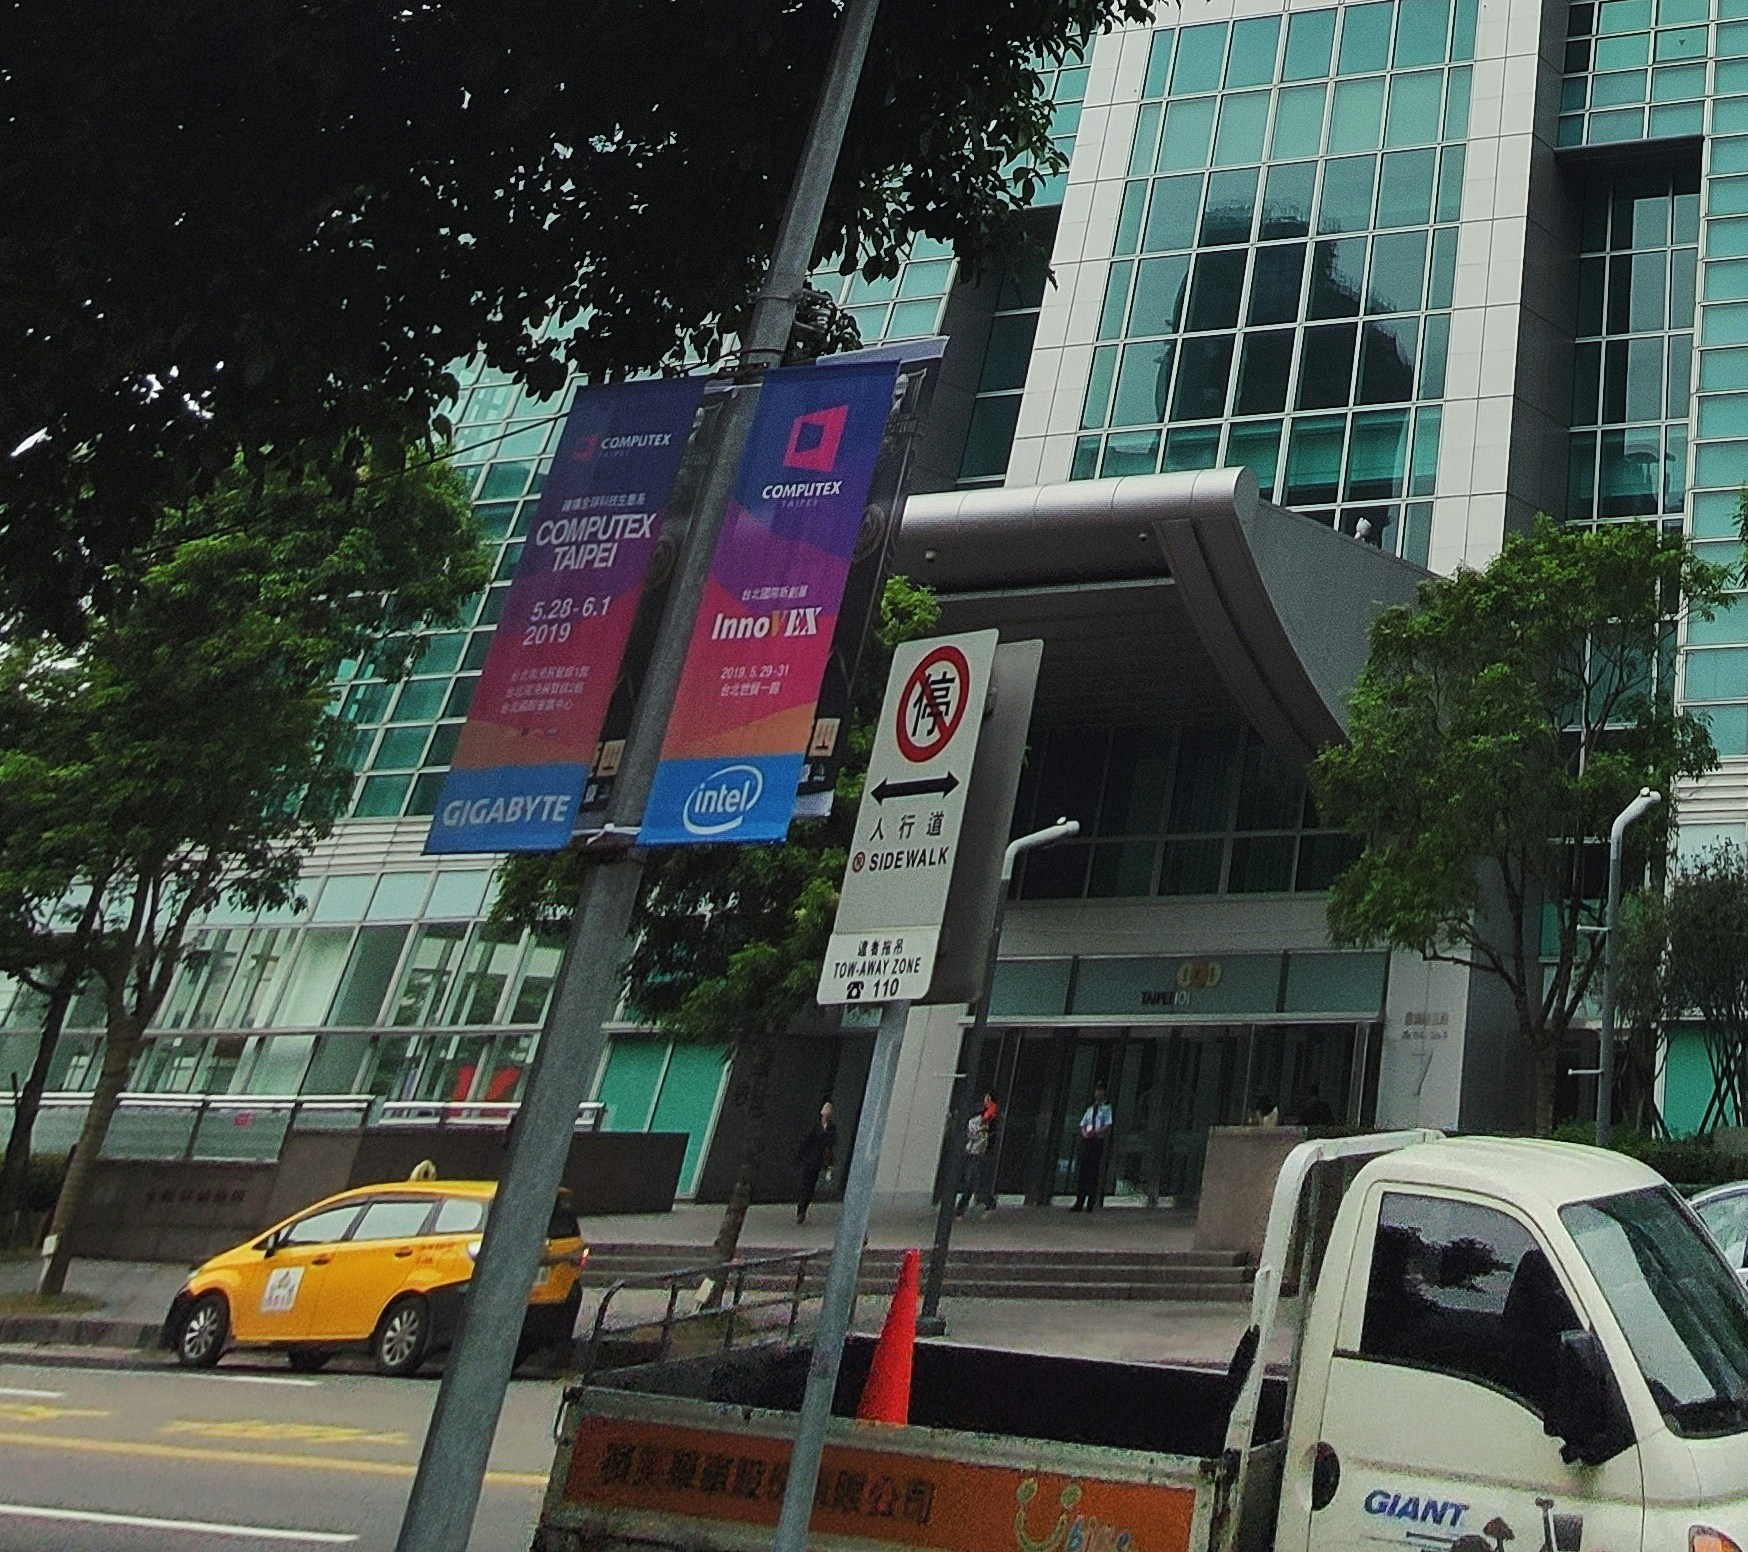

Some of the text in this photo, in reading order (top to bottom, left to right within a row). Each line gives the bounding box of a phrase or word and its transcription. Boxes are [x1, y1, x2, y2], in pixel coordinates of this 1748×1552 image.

[601, 433, 672, 450] COMPUTEX
[762, 480, 843, 499] COMPUTEX
[536, 513, 657, 546] COMPUTEX
[553, 542, 619, 573] TAIPEI
[522, 622, 571, 646] 2019
[711, 606, 823, 640] InnoVEX
[912, 671, 956, 737] 停
[442, 795, 572, 827] GIGABYTE
[694, 780, 751, 814] intel
[869, 811, 945, 842] 人行道
[868, 847, 949, 872] SIDEWALK
[833, 957, 922, 979] TOW-AWAY ZONE
[873, 977, 900, 998] 110
[1363, 1488, 1470, 1528] GIANT
